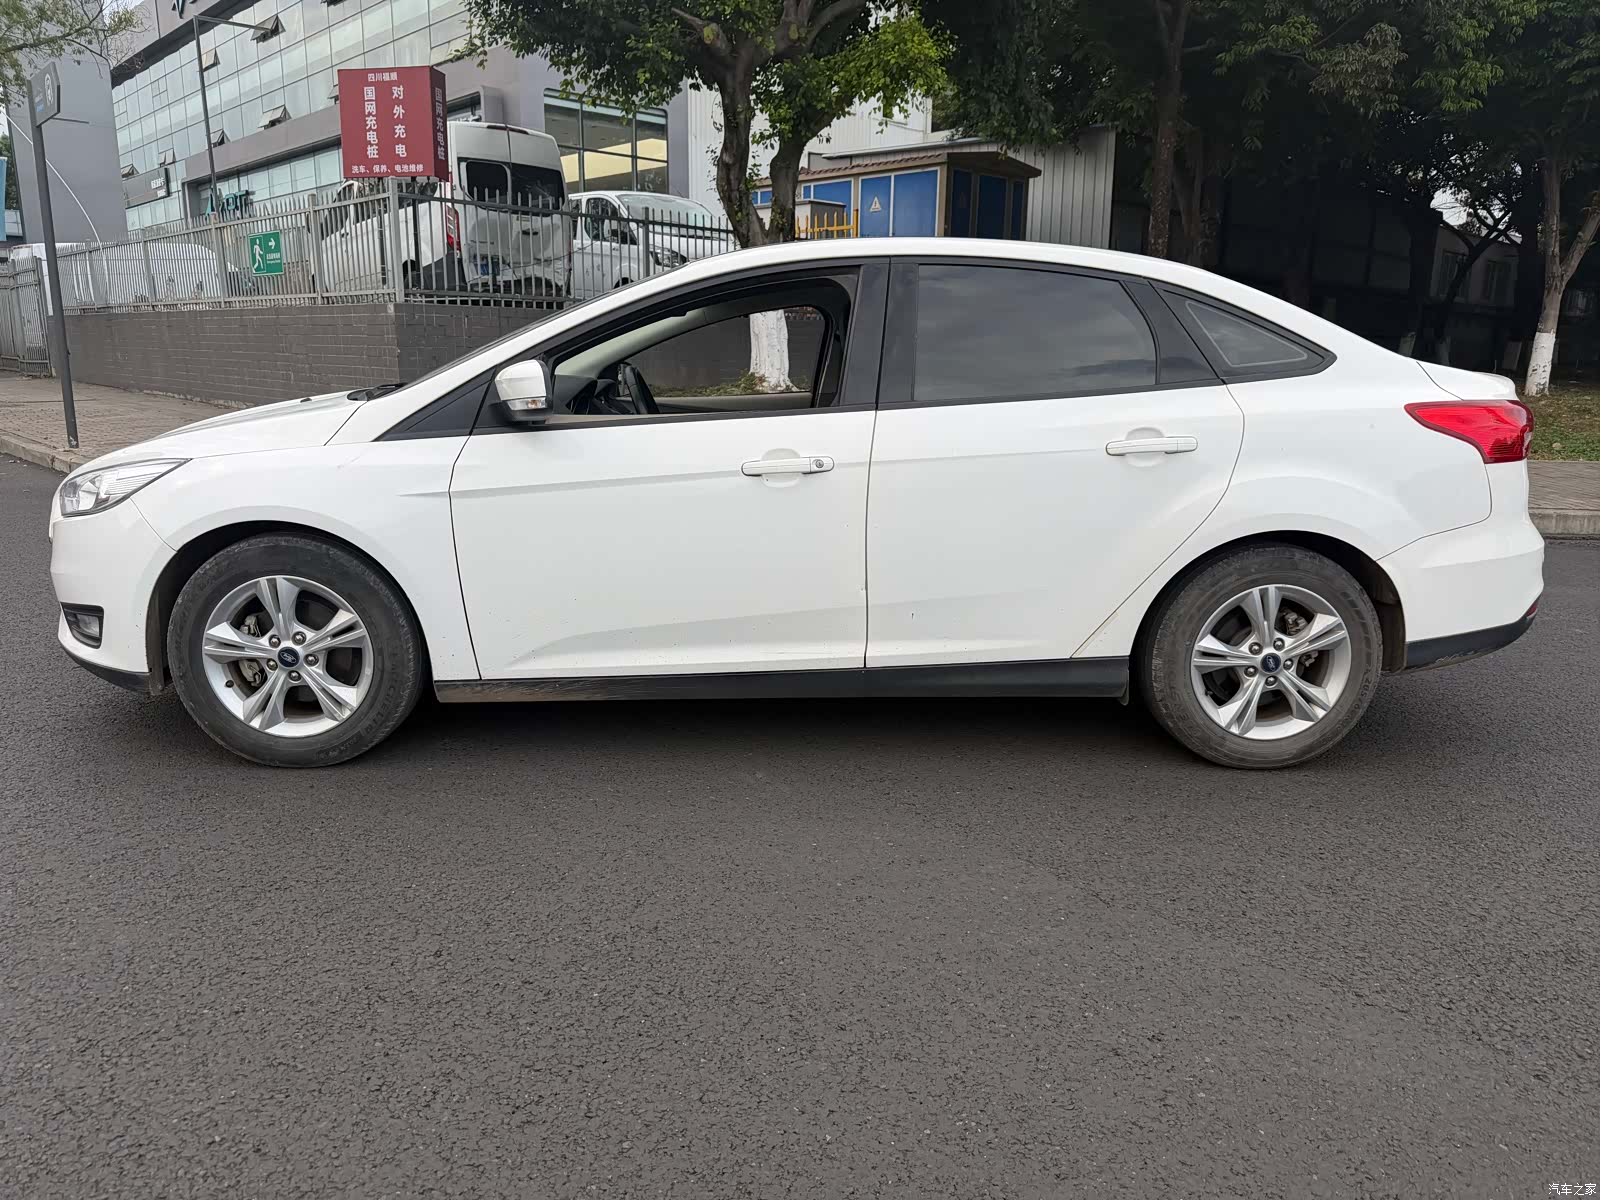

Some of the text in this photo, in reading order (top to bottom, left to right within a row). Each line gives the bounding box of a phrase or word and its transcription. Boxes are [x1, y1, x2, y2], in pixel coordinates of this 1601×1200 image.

[363, 86, 379, 159] 国网充电桩
[391, 85, 407, 158] 对外充电
[434, 87, 446, 161] 国网充电桩
